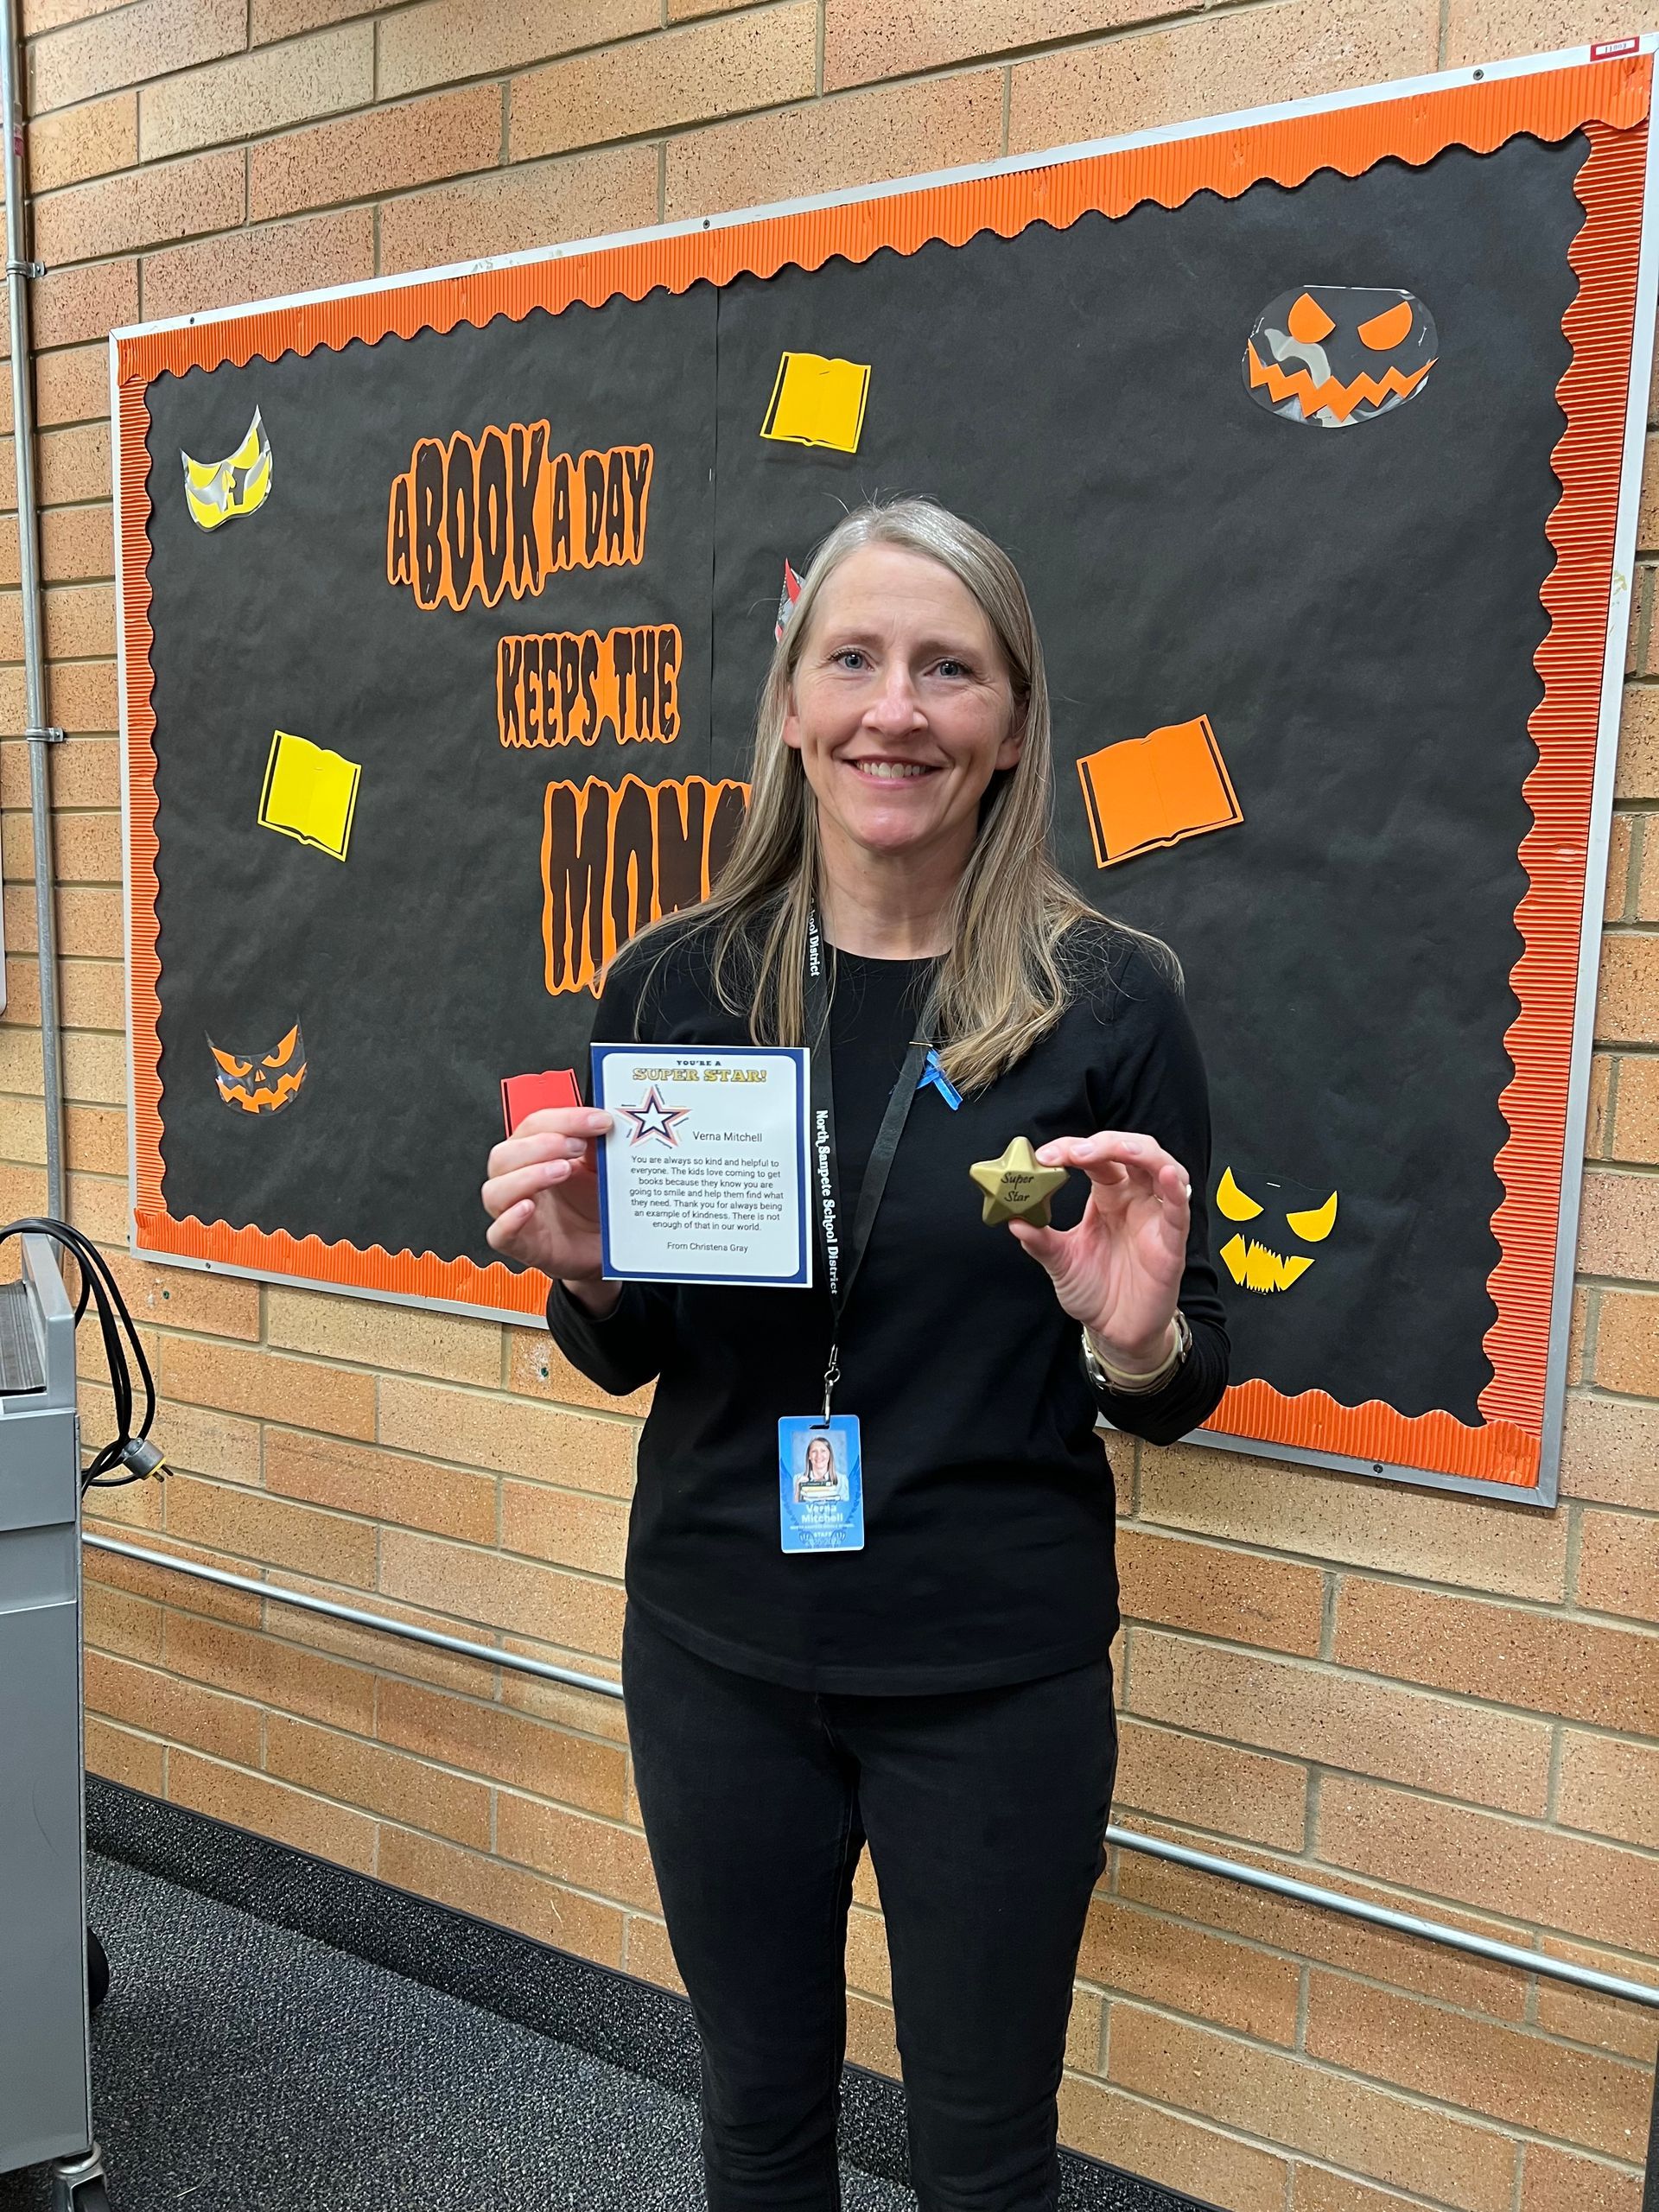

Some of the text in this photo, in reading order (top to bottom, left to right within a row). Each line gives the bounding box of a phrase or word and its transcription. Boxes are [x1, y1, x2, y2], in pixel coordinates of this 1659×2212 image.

[391, 423, 650, 607] A BOOK A DAY
[501, 627, 678, 745] KEEPS THE
[810, 936, 821, 976] District
[632, 1068, 767, 1083] SUPER STAR!
[693, 1131, 762, 1142] Verna Mitchell
[664, 1156, 691, 1166] always
[741, 1159, 768, 1167] helpful
[671, 1166, 686, 1175] The
[725, 1169, 755, 1179] coming
[767, 1171, 780, 1179] get
[665, 1178, 699, 1186] because
[701, 1179, 718, 1188] they
[1001, 1172, 1034, 1190] Super
[629, 1188, 652, 1197] going
[704, 1190, 721, 1198] help
[1004, 1191, 1030, 1202] Star
[631, 1198, 648, 1208] they
[674, 1199, 698, 1208] Thank
[716, 1200, 728, 1209] for
[730, 1201, 758, 1211] always
[760, 1203, 783, 1211] being
[815, 1109, 838, 1294] North Sanpete School District
[692, 1211, 730, 1219] kindness.
[732, 1211, 755, 1220] There
[652, 1221, 682, 1230] enough
[694, 1221, 710, 1230] that
[690, 1243, 728, 1251] Christena
[729, 1243, 748, 1253] Gray
[801, 1513, 843, 1523] Mitchell
